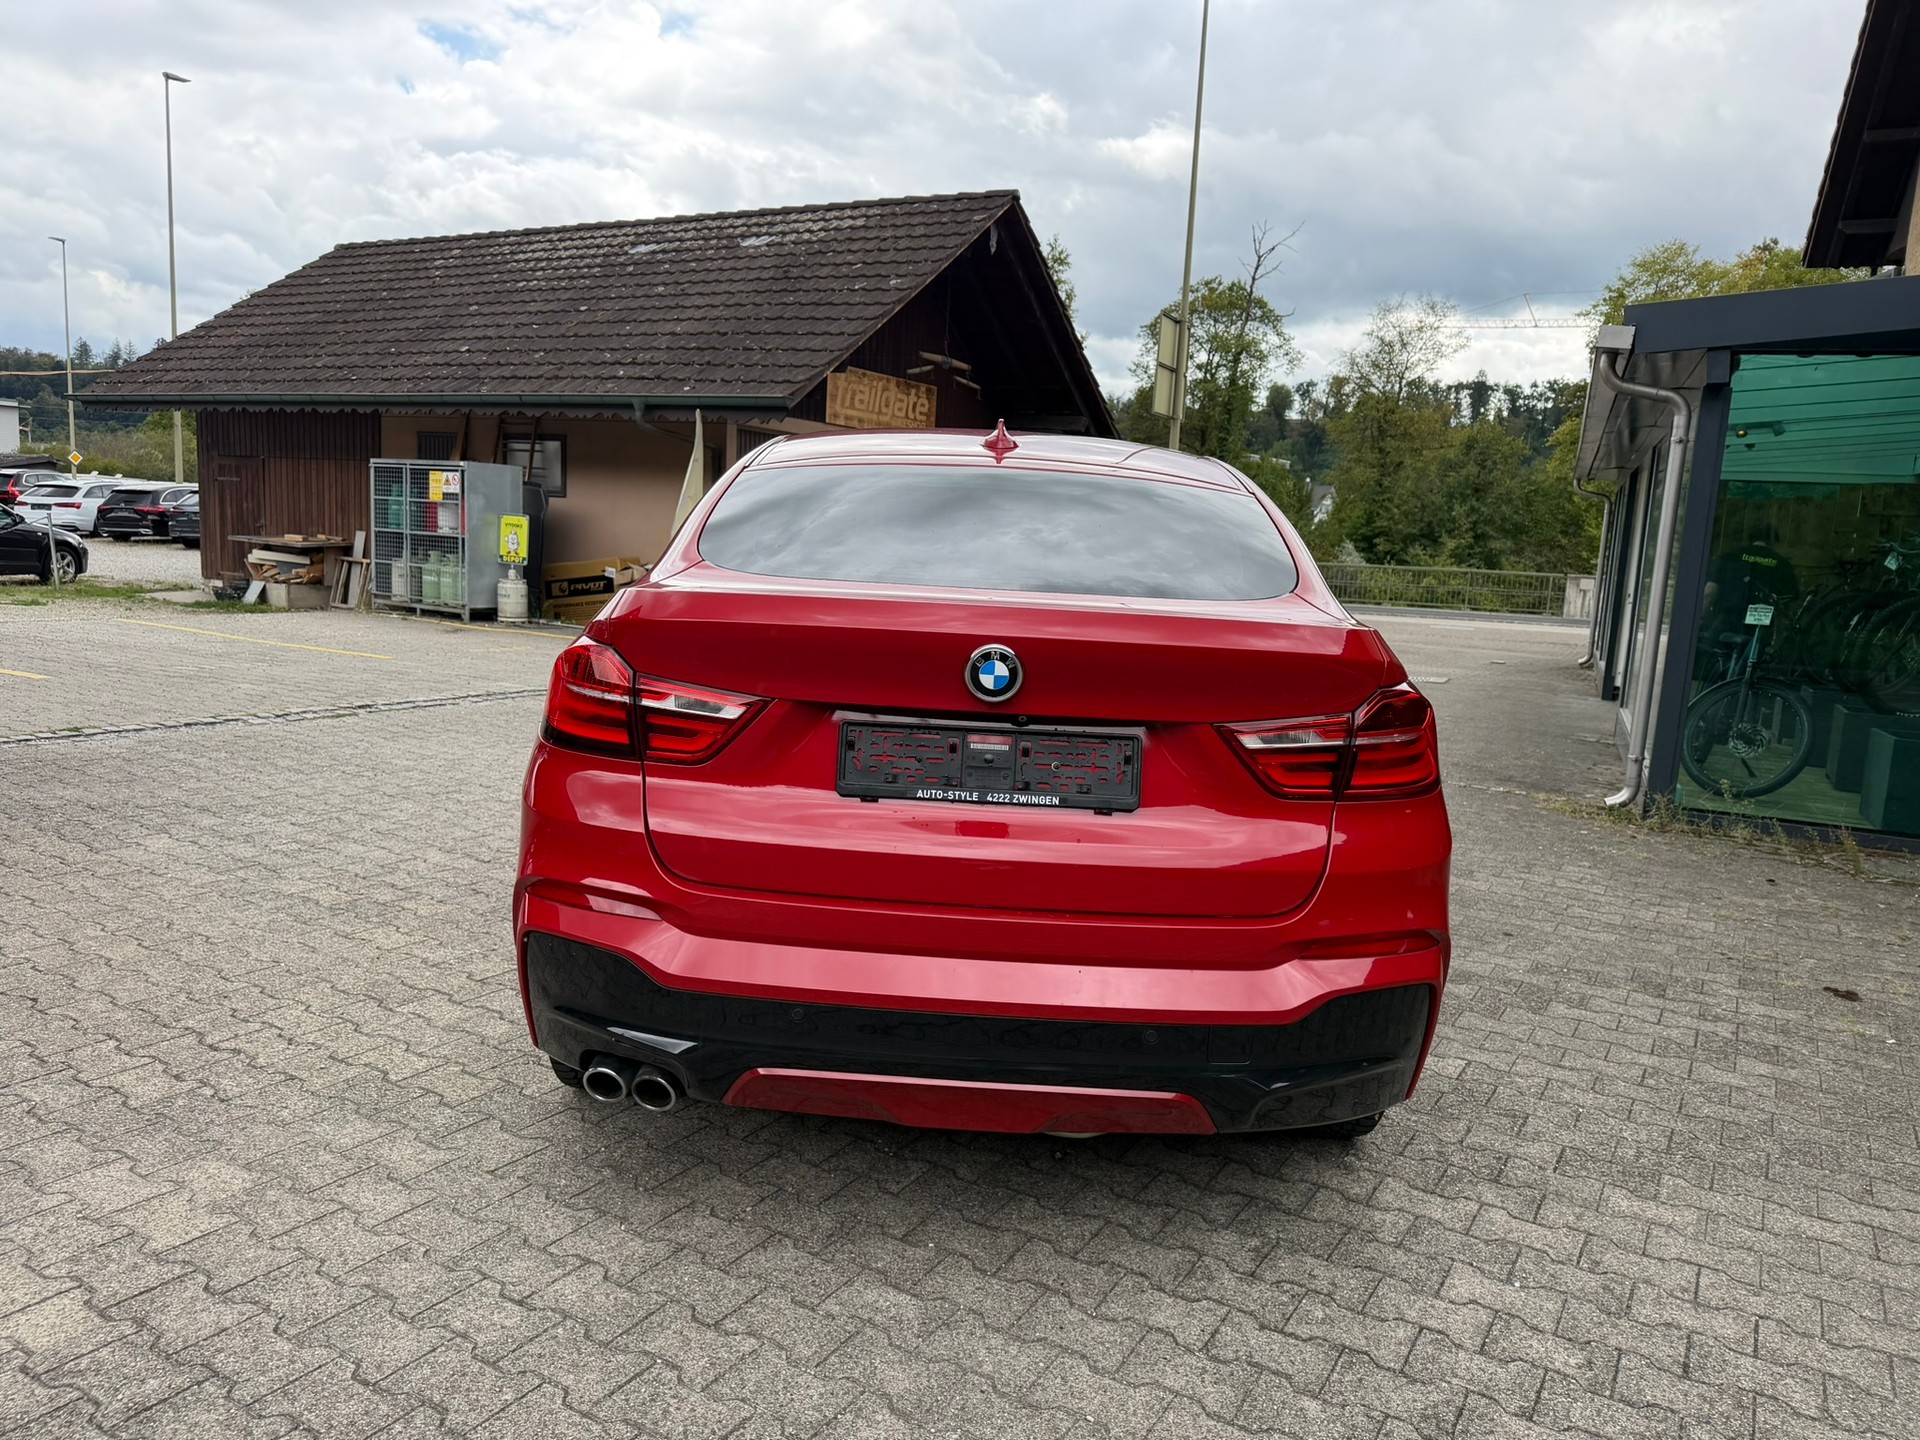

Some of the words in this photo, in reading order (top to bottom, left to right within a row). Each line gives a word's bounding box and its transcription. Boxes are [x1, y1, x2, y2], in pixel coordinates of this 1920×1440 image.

[570, 581, 607, 591] PIVOT
[974, 651, 1016, 669] BMW
[916, 789, 979, 801] AUTO-STYLE
[986, 792, 1011, 803] 4222
[1012, 794, 1060, 806] ZWINGEN
